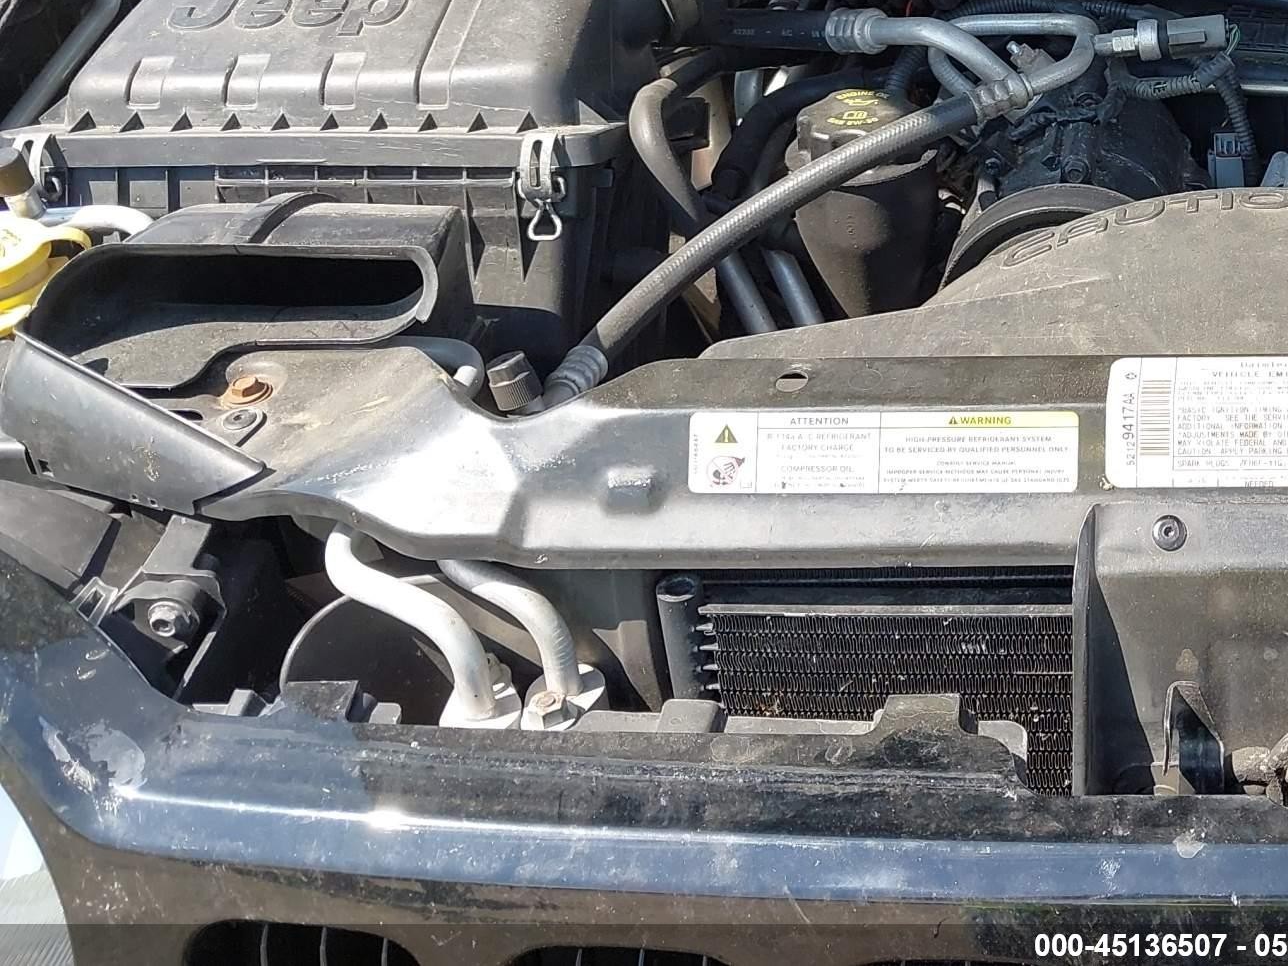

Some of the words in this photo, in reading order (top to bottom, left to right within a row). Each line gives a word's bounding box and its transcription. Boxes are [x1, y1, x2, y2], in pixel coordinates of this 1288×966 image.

[835, 91, 875, 100] ENGINE
[790, 417, 849, 425] ATTENTION
[960, 416, 1012, 425] WARNING
[896, 446, 906, 454] BE
